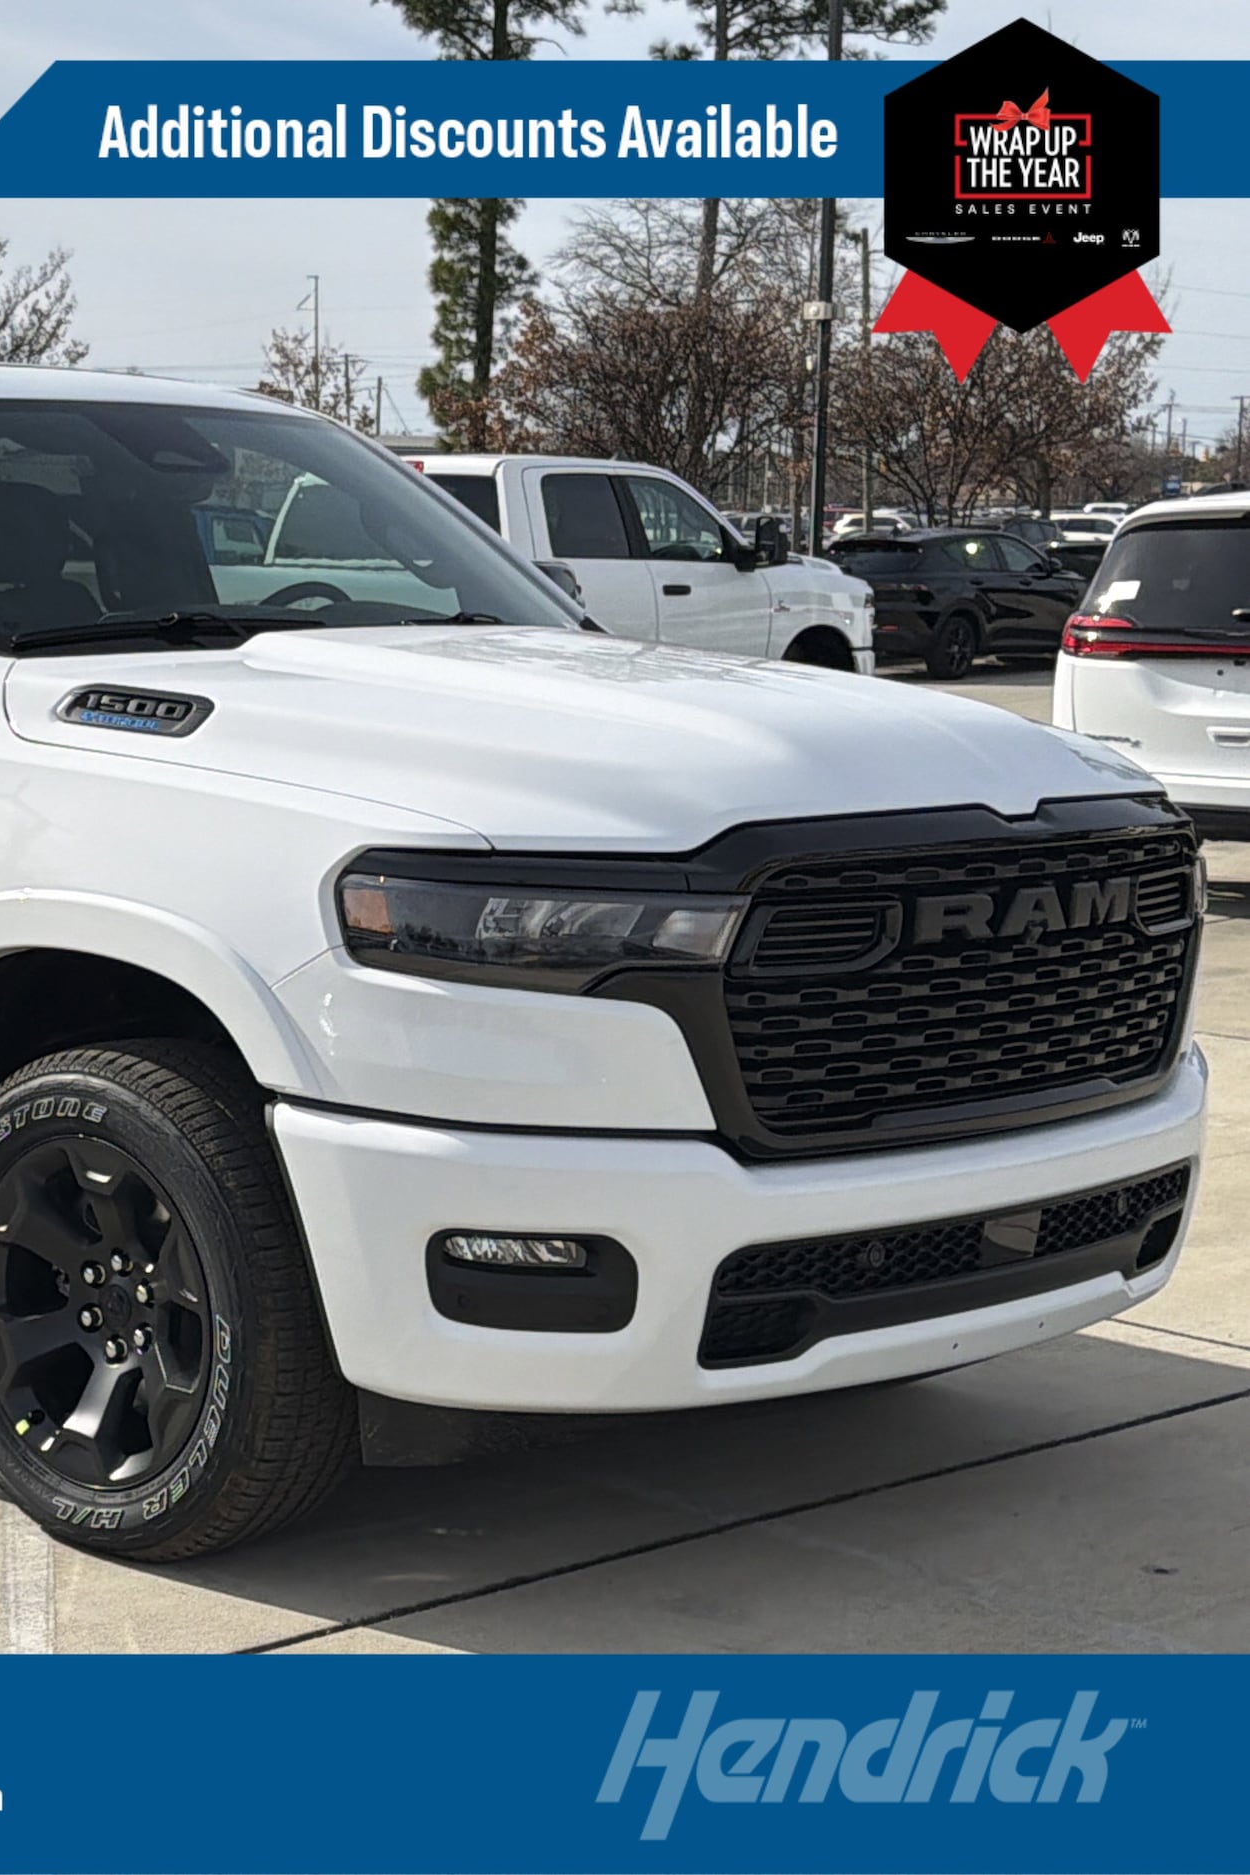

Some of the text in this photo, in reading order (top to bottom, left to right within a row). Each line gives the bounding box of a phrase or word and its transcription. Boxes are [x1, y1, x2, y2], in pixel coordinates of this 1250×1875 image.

[85, 692, 188, 720] 1500
[913, 876, 1132, 946] RAM
[142, 1313, 232, 1521] DUELER
